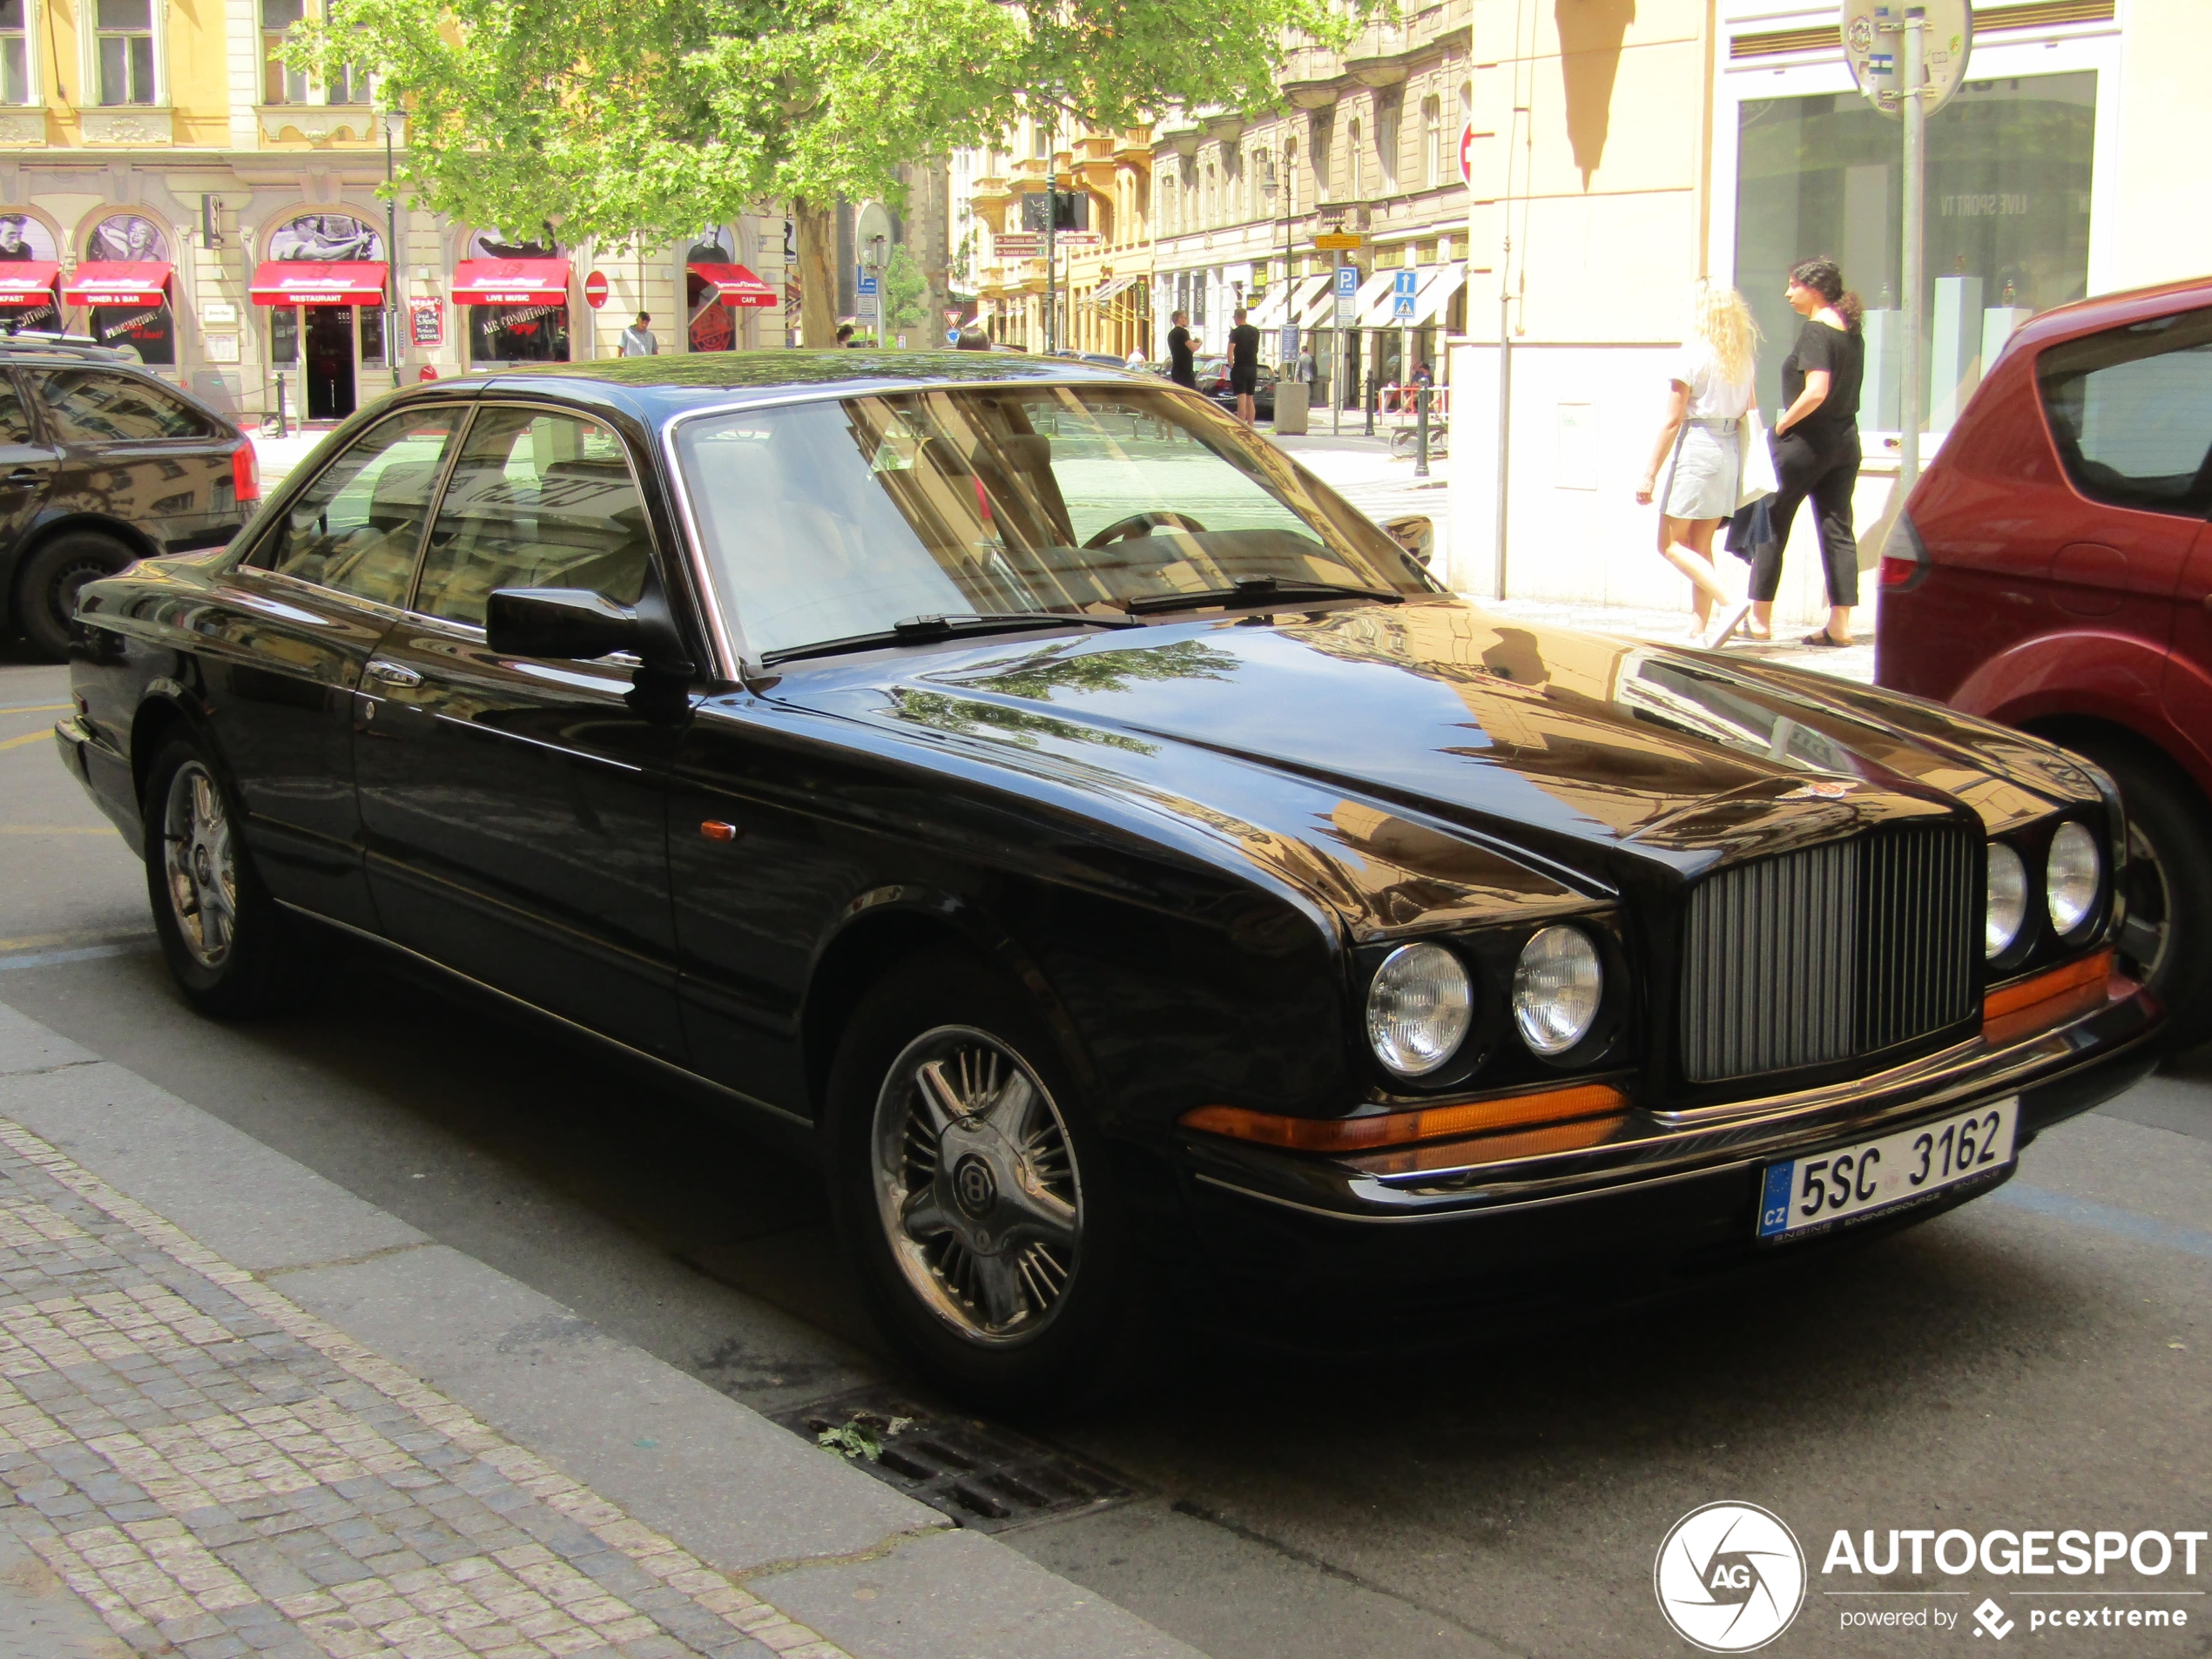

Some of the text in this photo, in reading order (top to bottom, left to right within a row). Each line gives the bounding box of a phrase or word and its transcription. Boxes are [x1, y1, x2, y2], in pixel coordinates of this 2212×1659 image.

[1340, 271, 1352, 288] P
[482, 320, 501, 335] AIR
[1800, 1110, 2000, 1216] 5SC 3162
[1764, 1207, 1785, 1226] CZ
